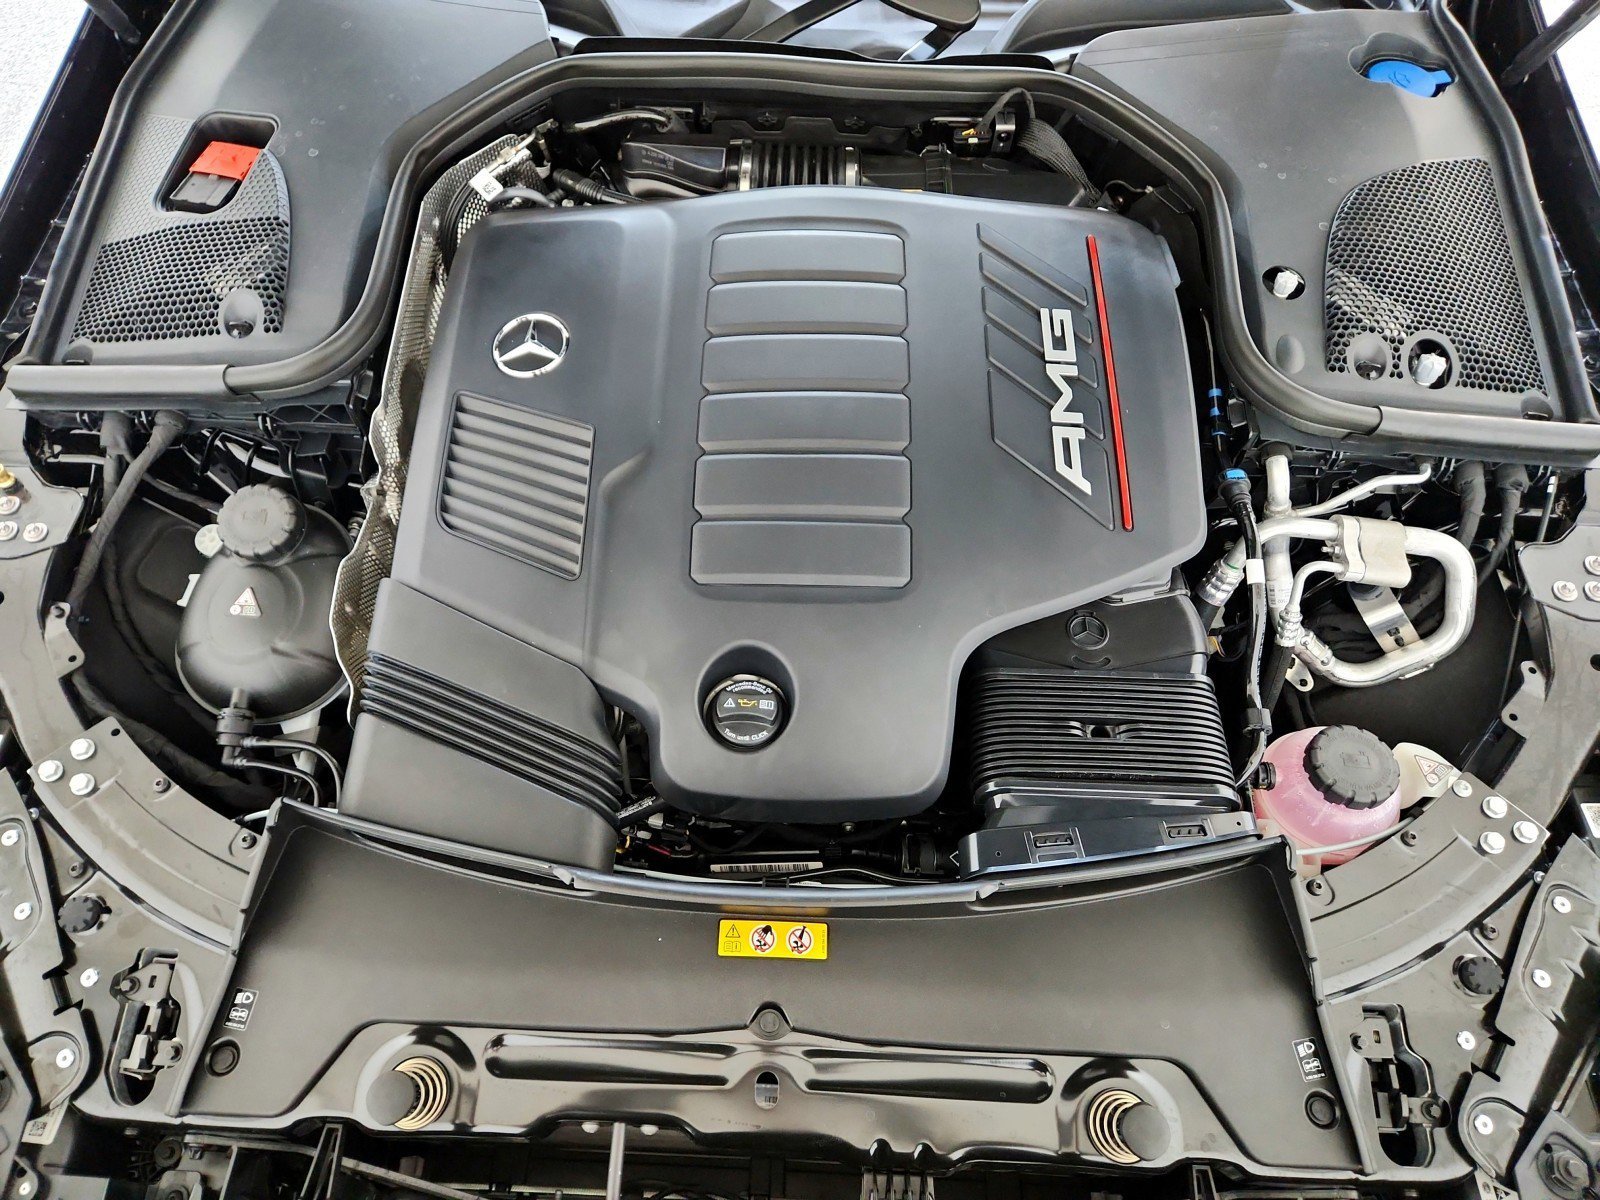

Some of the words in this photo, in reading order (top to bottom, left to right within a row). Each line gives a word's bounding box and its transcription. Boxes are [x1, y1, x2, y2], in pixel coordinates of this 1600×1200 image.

[1040, 307, 1092, 496] AMG
[724, 728, 736, 739] Turn
[751, 730, 769, 741] CLICK
